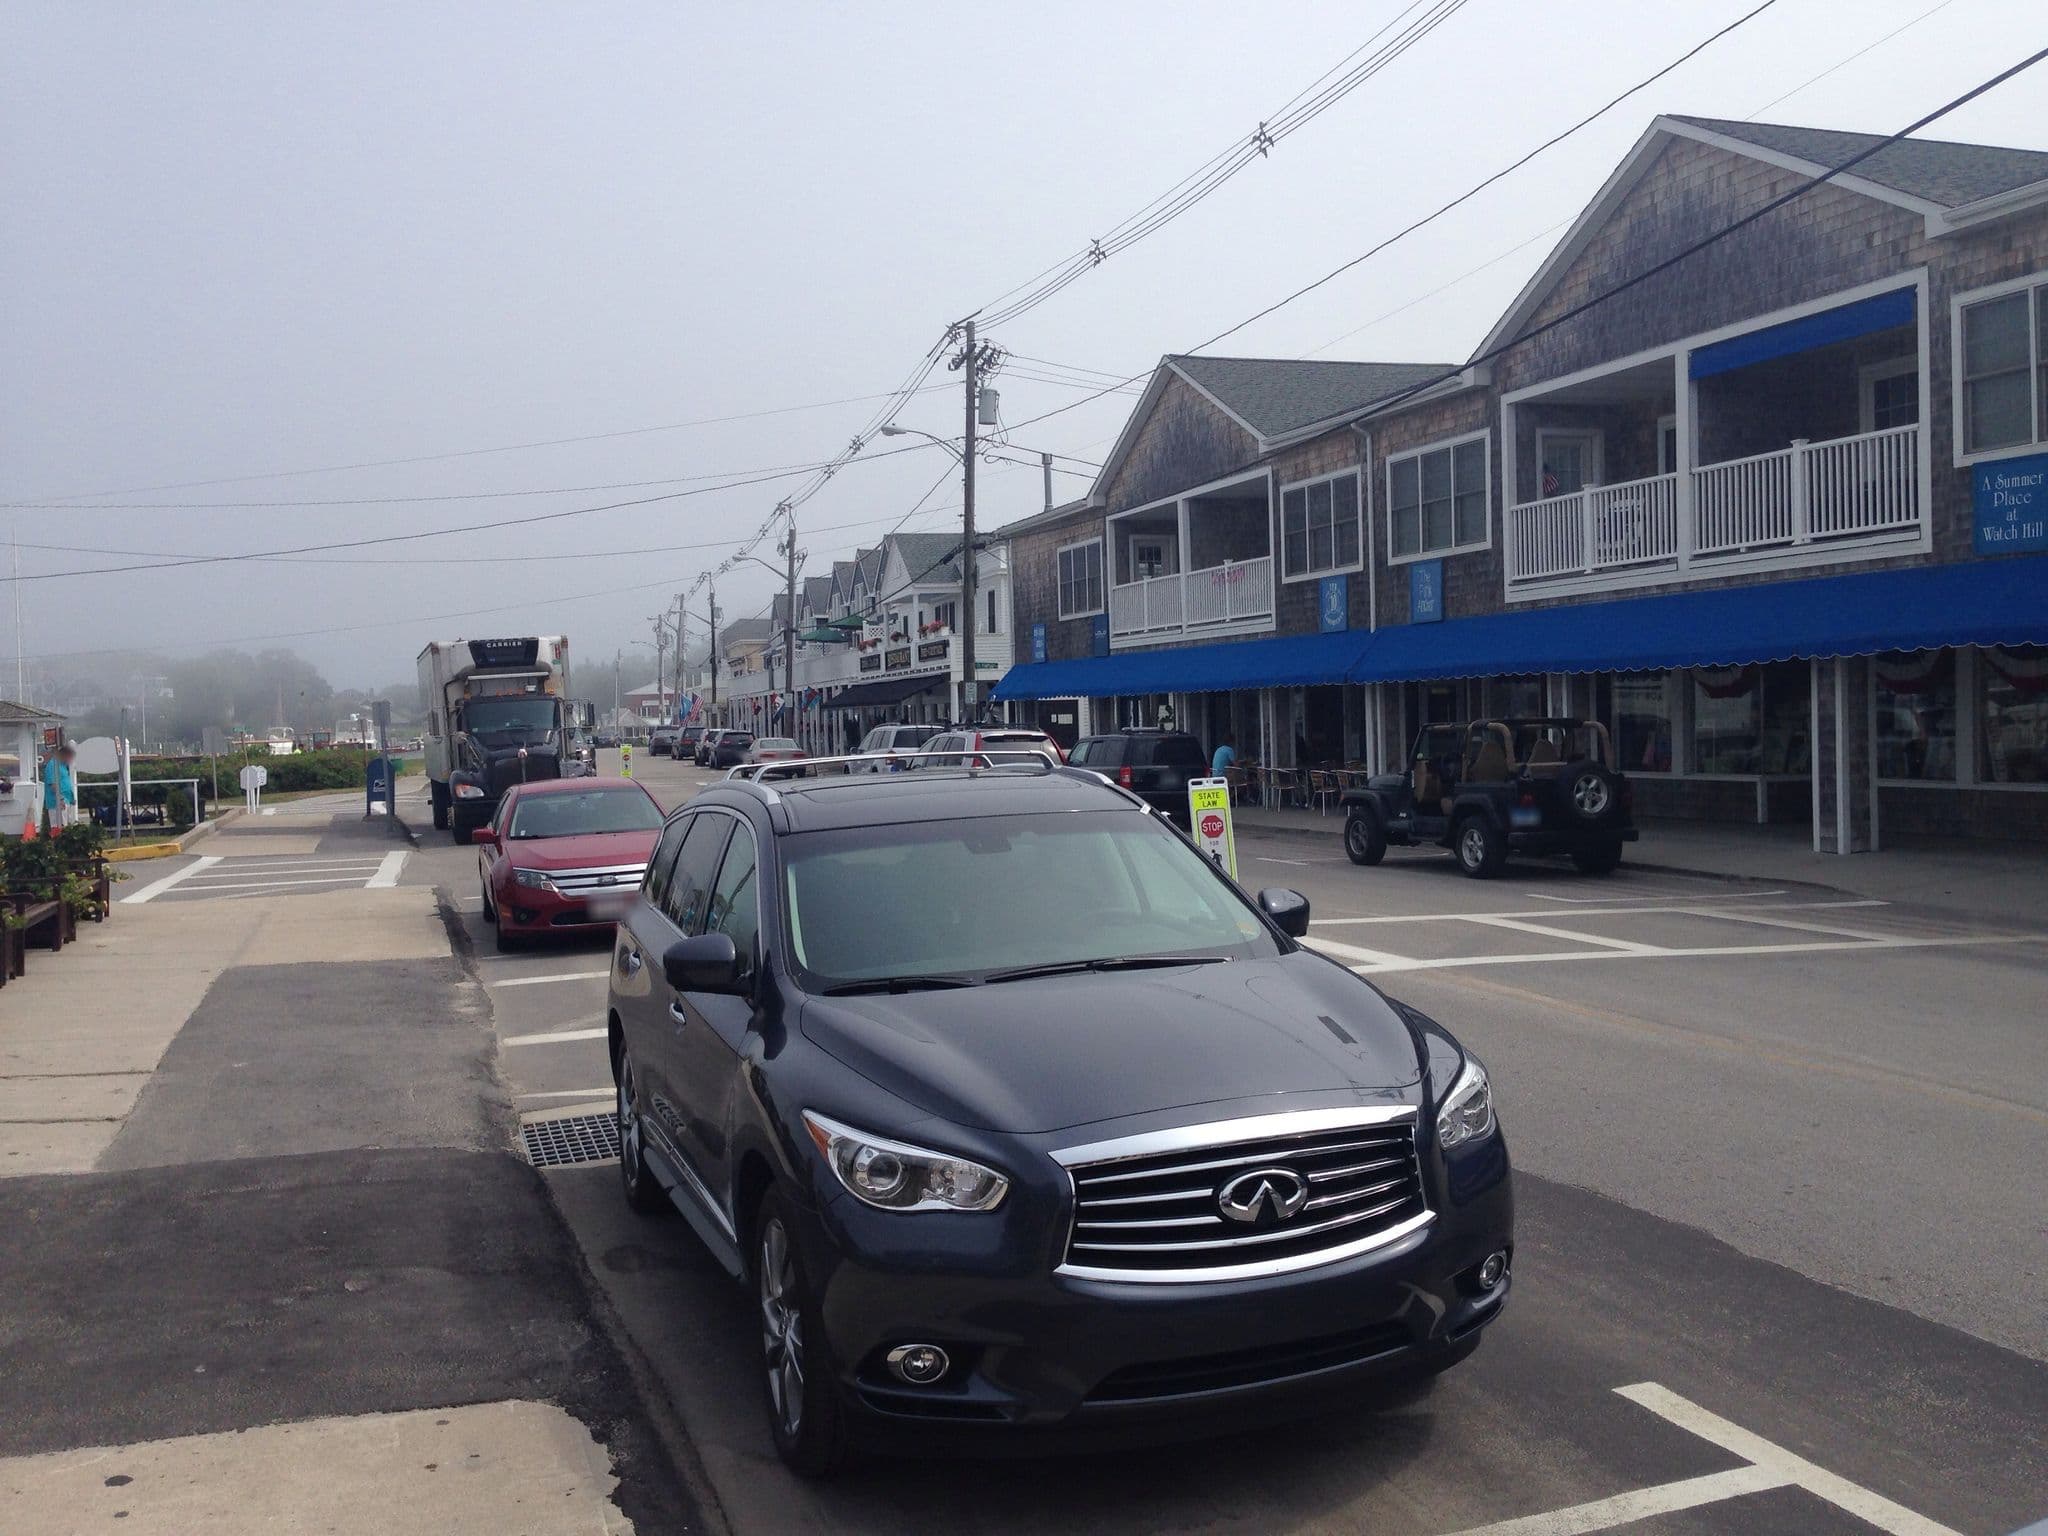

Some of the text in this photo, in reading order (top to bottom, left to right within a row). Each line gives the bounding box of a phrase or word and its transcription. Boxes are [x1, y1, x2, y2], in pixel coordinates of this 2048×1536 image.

[1982, 473, 2044, 491] A Summer
[1993, 490, 2032, 507] Place
[2006, 508, 2018, 522] at
[1983, 521, 2043, 541] Watch Hill
[1198, 791, 1220, 800] STATE
[1202, 800, 1218, 808] LAW
[1202, 821, 1222, 832] STOP
